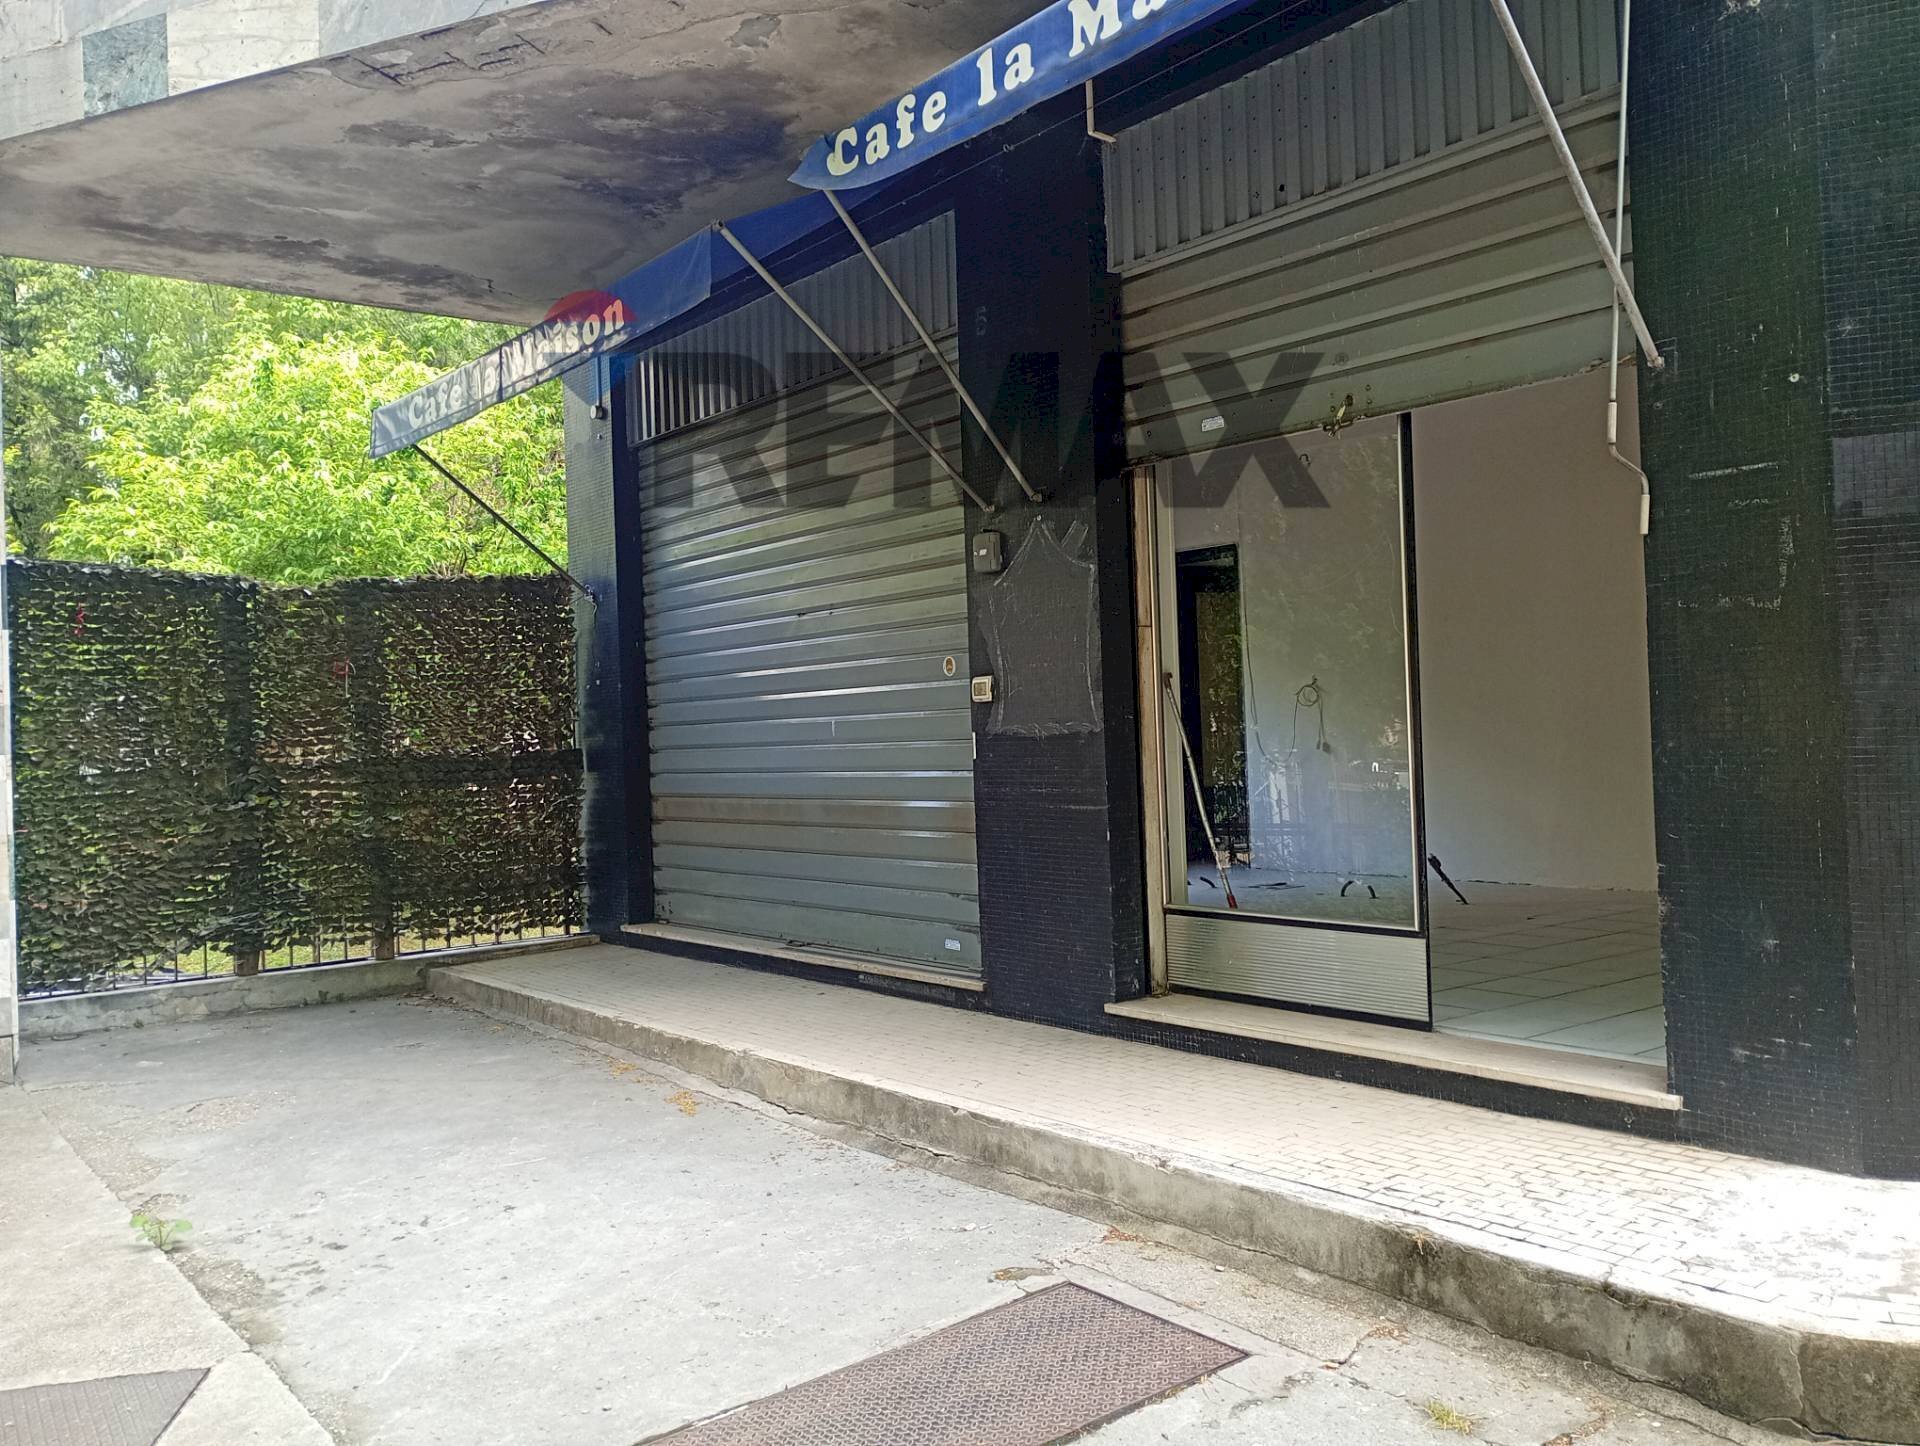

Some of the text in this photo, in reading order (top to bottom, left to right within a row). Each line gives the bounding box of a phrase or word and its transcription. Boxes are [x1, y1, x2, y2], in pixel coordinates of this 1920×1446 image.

[825, 88, 948, 177] Cafe
[976, 42, 1036, 106] la
[408, 381, 463, 429] Cafe
[471, 363, 497, 401] la
